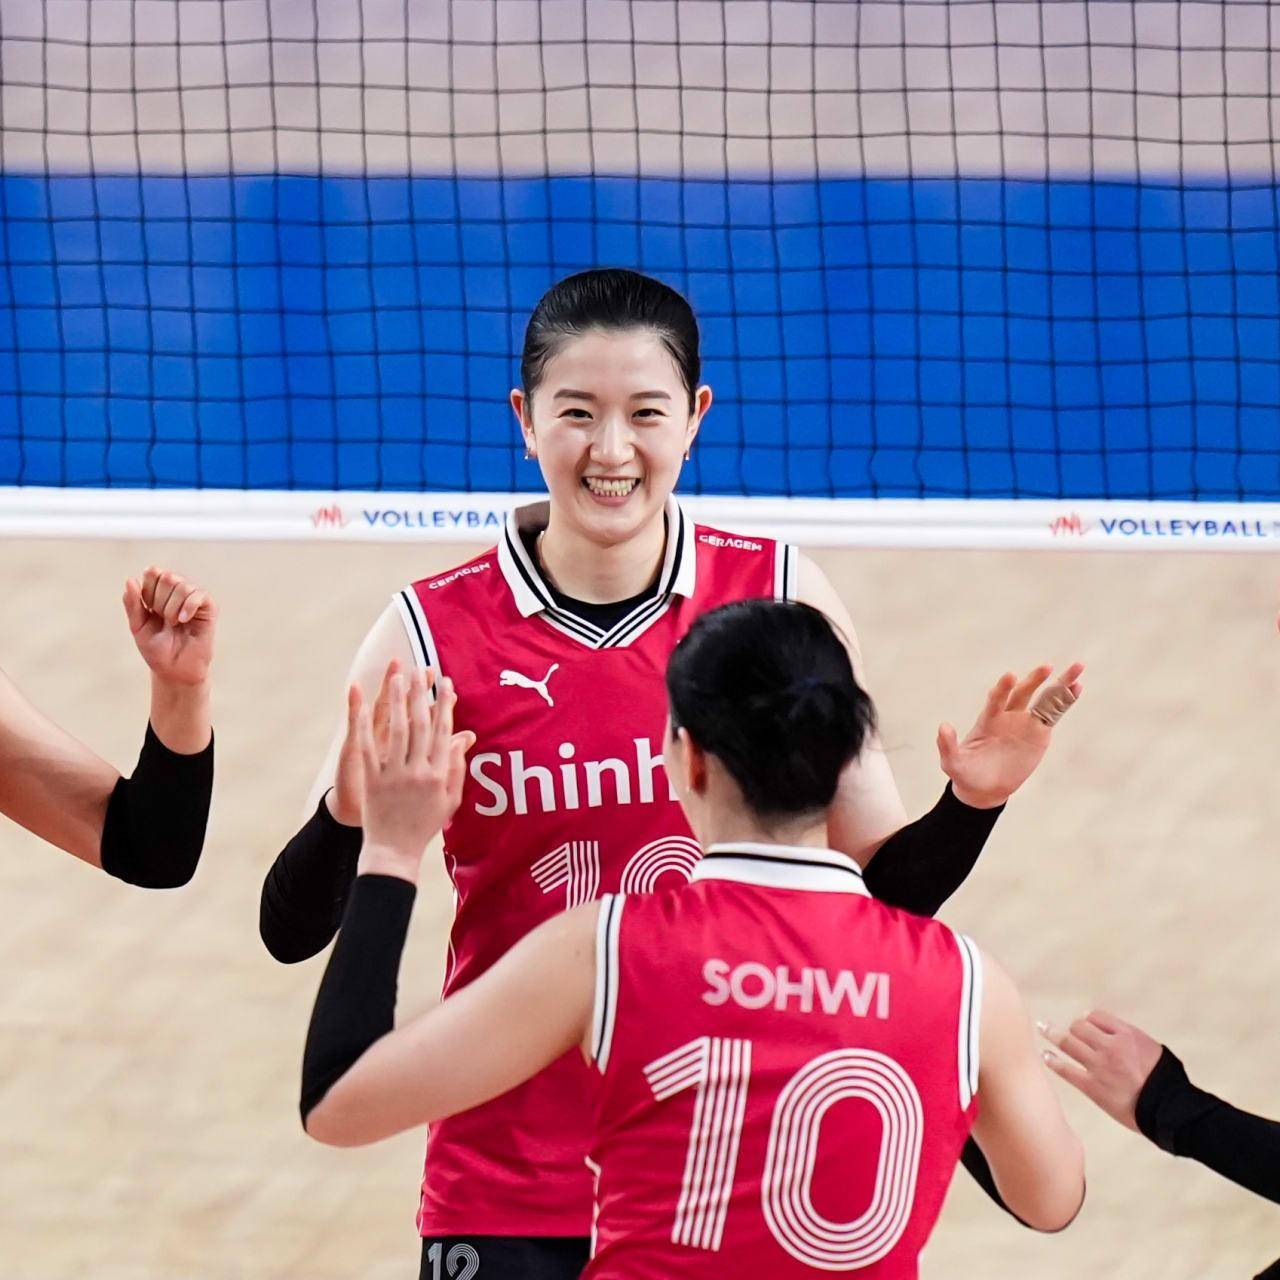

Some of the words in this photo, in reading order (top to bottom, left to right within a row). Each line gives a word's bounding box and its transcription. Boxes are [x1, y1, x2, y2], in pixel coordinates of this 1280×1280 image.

[1099, 518, 1268, 538] VOLLEYBALL
[702, 957, 890, 1020] SOHWI
[642, 1035, 924, 1272] 10
